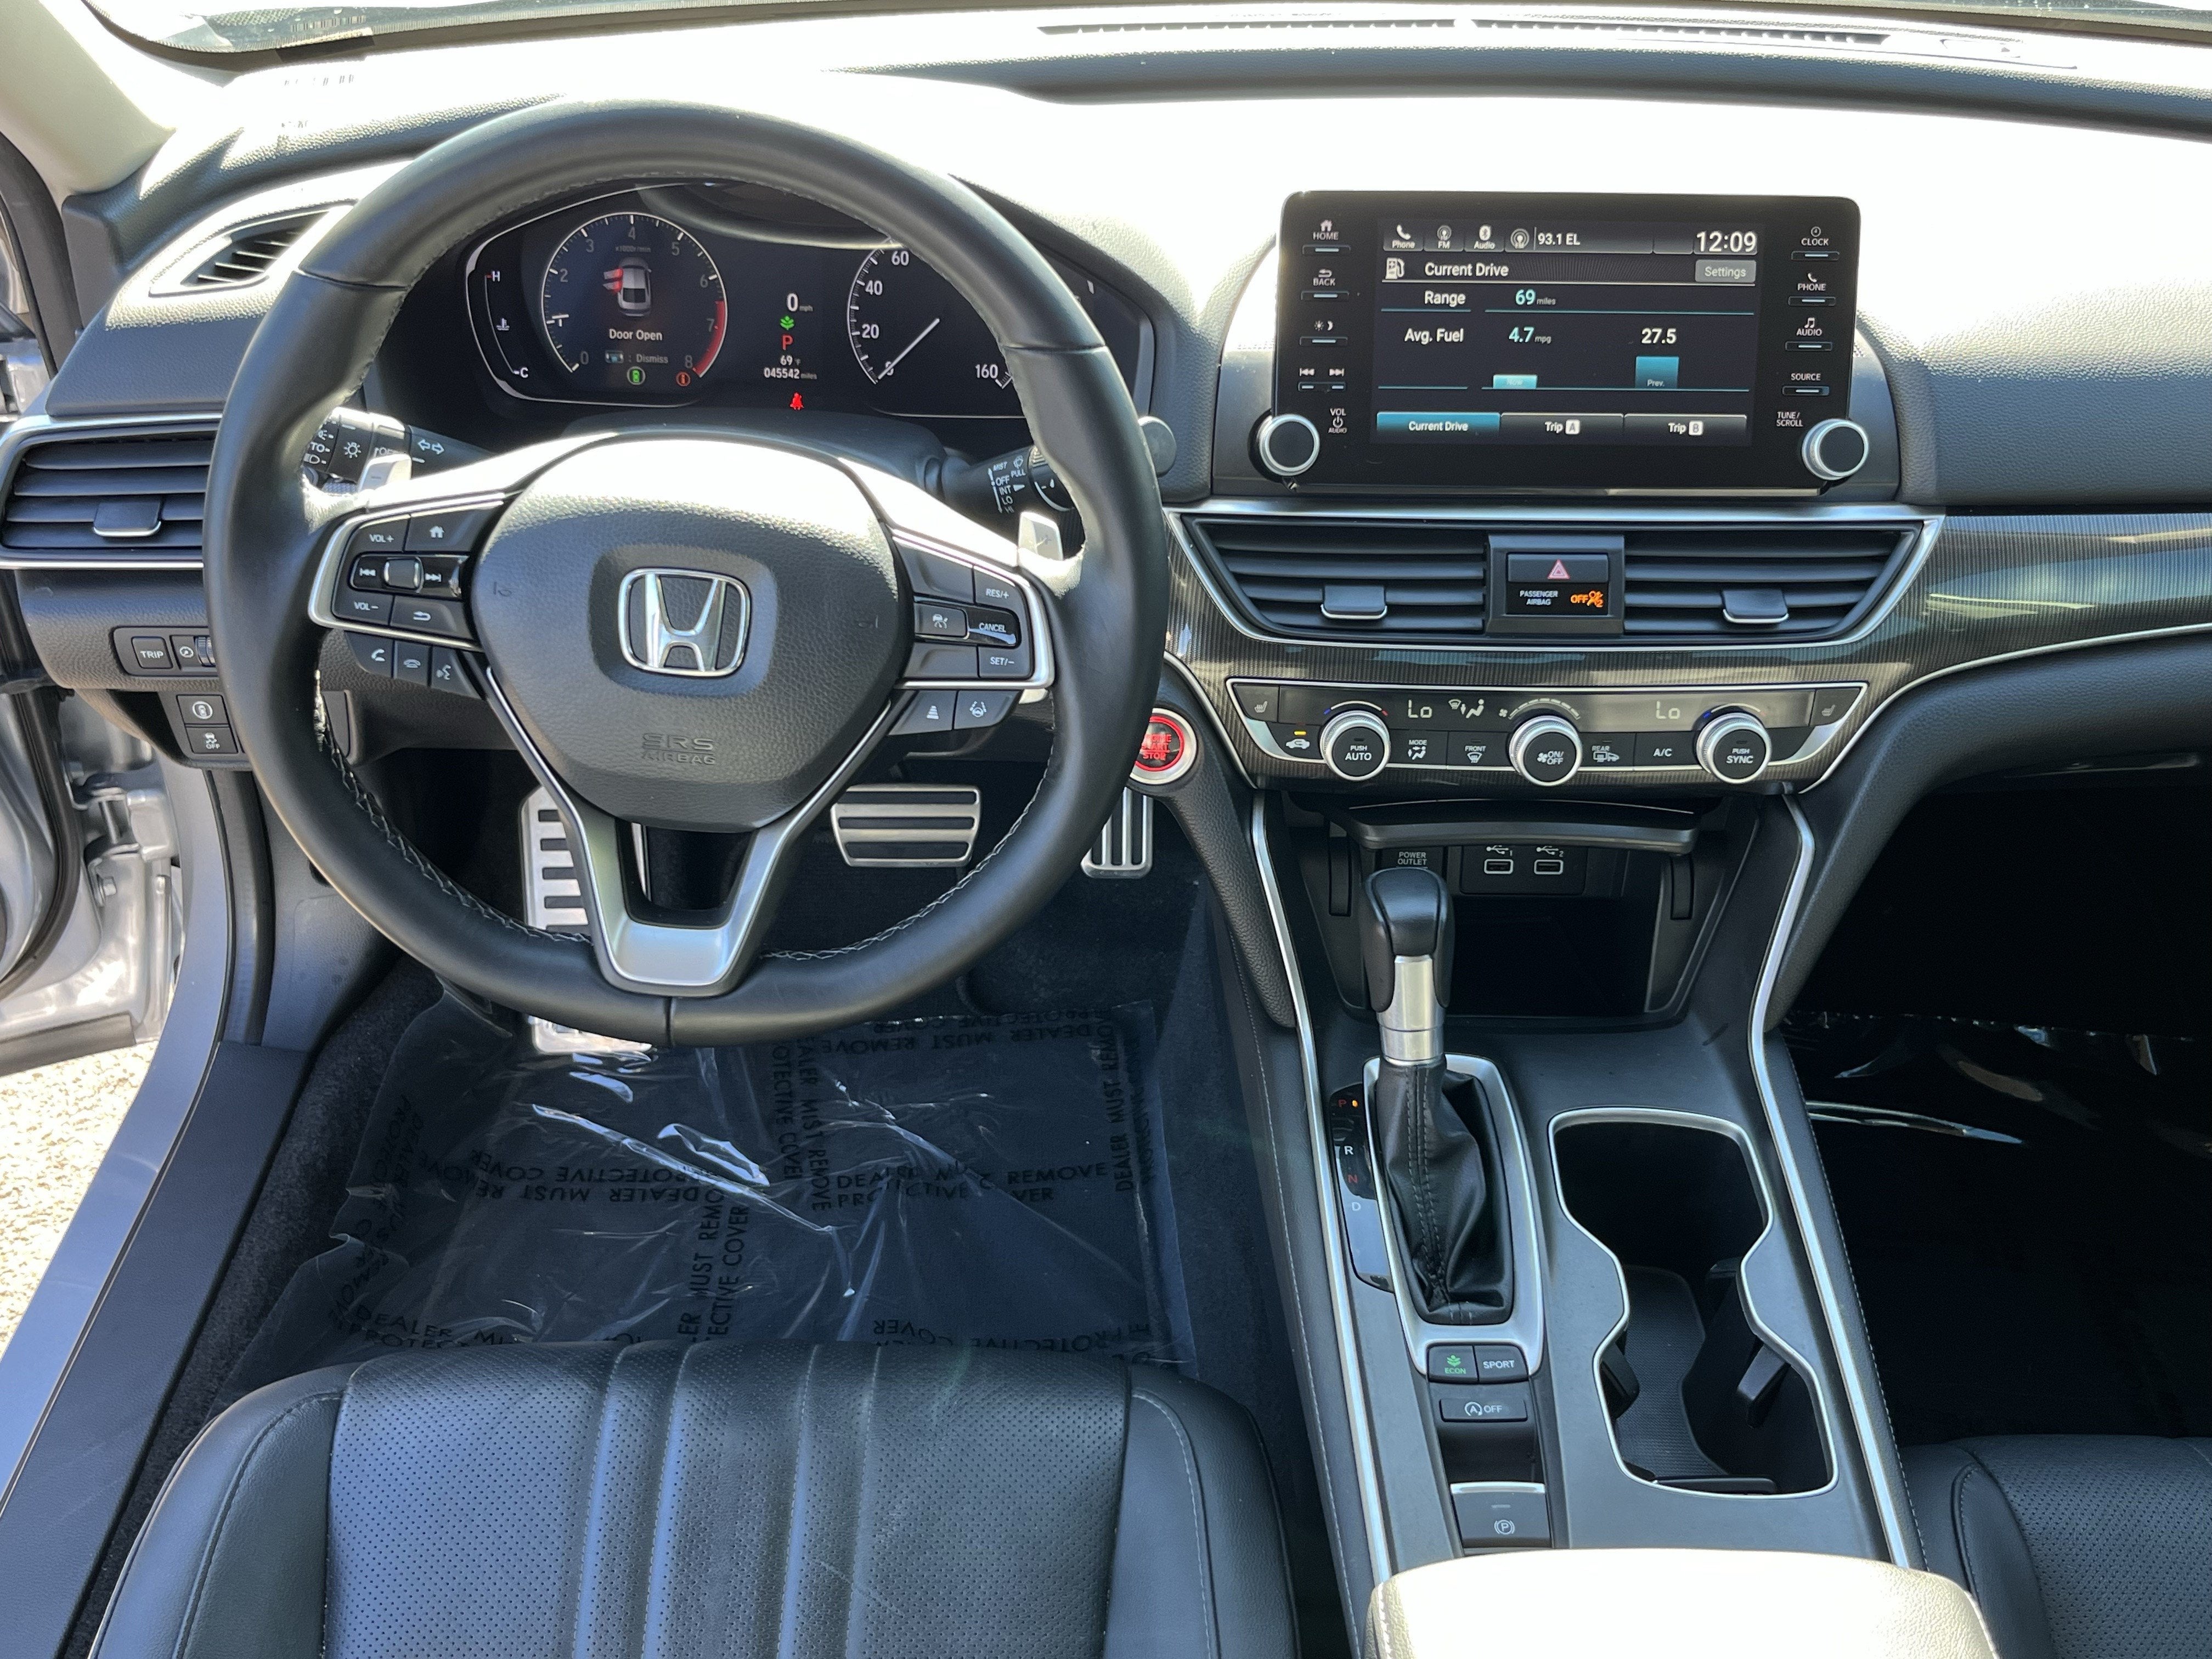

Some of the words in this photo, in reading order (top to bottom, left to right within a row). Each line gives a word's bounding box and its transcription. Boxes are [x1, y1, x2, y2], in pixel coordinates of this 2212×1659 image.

[628, 227, 636, 240] 4
[1313, 232, 1339, 240] HOME
[1538, 233, 1562, 245] 93.1
[1566, 234, 1581, 245] EL
[586, 239, 594, 252] 3
[1392, 240, 1415, 249] Phone
[1696, 231, 1756, 253] 12:09
[1801, 238, 1829, 246] CLOCK
[672, 242, 680, 256] 5
[891, 251, 910, 266] 60
[1425, 262, 1472, 276] Current
[1476, 262, 1509, 276] Drive
[1705, 266, 1746, 279] Settings
[492, 271, 500, 281] H
[560, 269, 568, 283] 2
[699, 274, 708, 287] 6
[1313, 278, 1336, 286] BACK
[865, 280, 883, 296] 40
[1797, 283, 1826, 291] PHONE
[787, 293, 798, 312] 0
[1425, 290, 1466, 307] Range
[1515, 289, 1536, 306] 69
[1536, 297, 1556, 306] miles
[707, 318, 714, 331] 7
[609, 329, 633, 340] Door
[636, 330, 663, 343] Open
[862, 324, 880, 338] 20
[1404, 329, 1432, 345] Avg.
[1436, 329, 1464, 342] Fuel
[1509, 328, 1534, 343] 4.7
[1535, 335, 1551, 345] mpg
[1641, 328, 1677, 344] 27.5
[1796, 328, 1822, 337] AUDIO
[782, 334, 793, 351] P
[580, 352, 589, 365] 0
[636, 353, 668, 364] Dismiss
[685, 355, 693, 368] 8
[780, 355, 793, 365] 69
[520, 367, 528, 378] C
[764, 367, 800, 379] 045542
[975, 364, 998, 379] 160
[1330, 408, 1347, 416] VOL
[1777, 411, 1800, 420] TUNE/
[1408, 421, 1442, 431] Current
[1444, 421, 1469, 431] Drive
[1545, 422, 1563, 433] Trip
[1668, 422, 1685, 434] Trip
[1776, 419, 1803, 427] SCROLL
[1011, 469, 1026, 478] PULL
[996, 475, 1009, 486] OFF
[999, 485, 1011, 495] INT
[1001, 495, 1013, 505] LO
[1570, 594, 1588, 603] OFF
[978, 622, 1006, 633] CANCEL
[140, 650, 164, 659] TRIP
[642, 733, 714, 751] SRS
[1143, 752, 1166, 761] STOP
[1345, 752, 1372, 761] AUTO
[1653, 748, 1673, 757] A/C
[1547, 757, 1564, 765] OFF
[1726, 755, 1754, 764] SYNC
[931, 1032, 992, 1049] MUST
[1103, 1081, 1125, 1123] MUST
[1345, 1146, 1354, 1155] R
[470, 1150, 544, 1182] COVER
[1110, 1133, 1134, 1192] DEALER
[1007, 1163, 1108, 1184] REMOVE
[808, 1150, 831, 1211] REMOVE
[520, 1186, 590, 1202] MUST
[609, 1187, 699, 1203] DEALER
[1351, 1202, 1361, 1211] D
[722, 1205, 749, 1266] COVER
[357, 1305, 452, 1337] DEALER
[1483, 1359, 1515, 1370] SPORT
[1483, 1405, 1503, 1414] OFF
